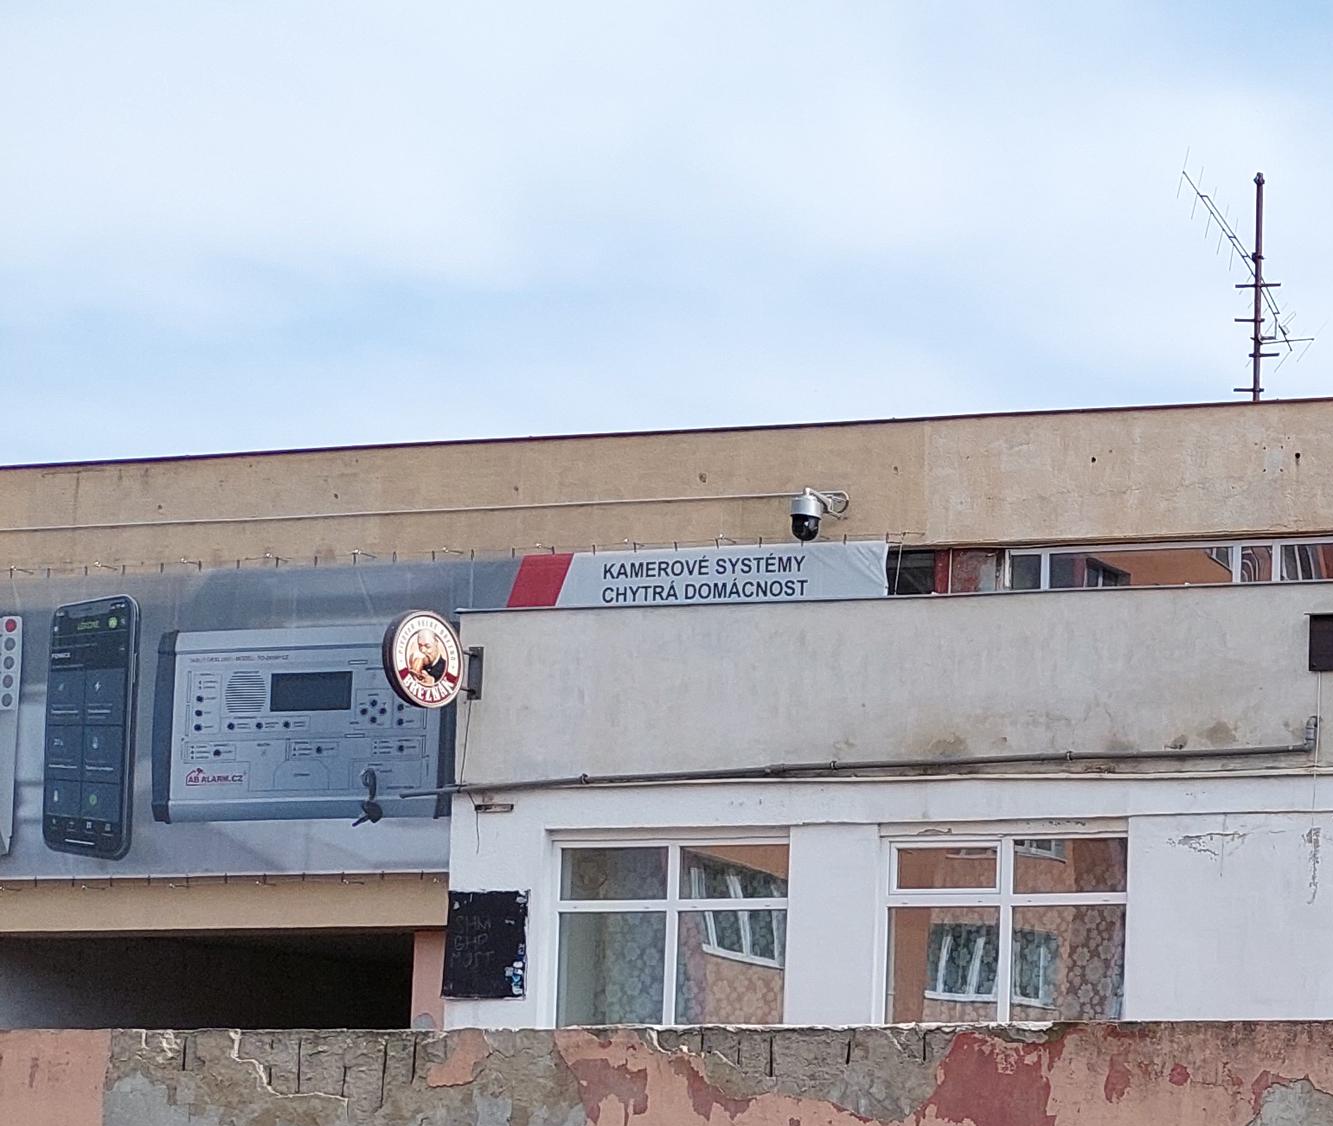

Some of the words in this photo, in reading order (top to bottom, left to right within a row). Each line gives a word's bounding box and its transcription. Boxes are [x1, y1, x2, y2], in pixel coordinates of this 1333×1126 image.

[602, 555, 710, 580] KAMEROVÉ
[715, 552, 807, 575] SYSTÉMY
[601, 580, 679, 603] CHYTRÁ
[684, 578, 809, 600] DOMÁCNOST
